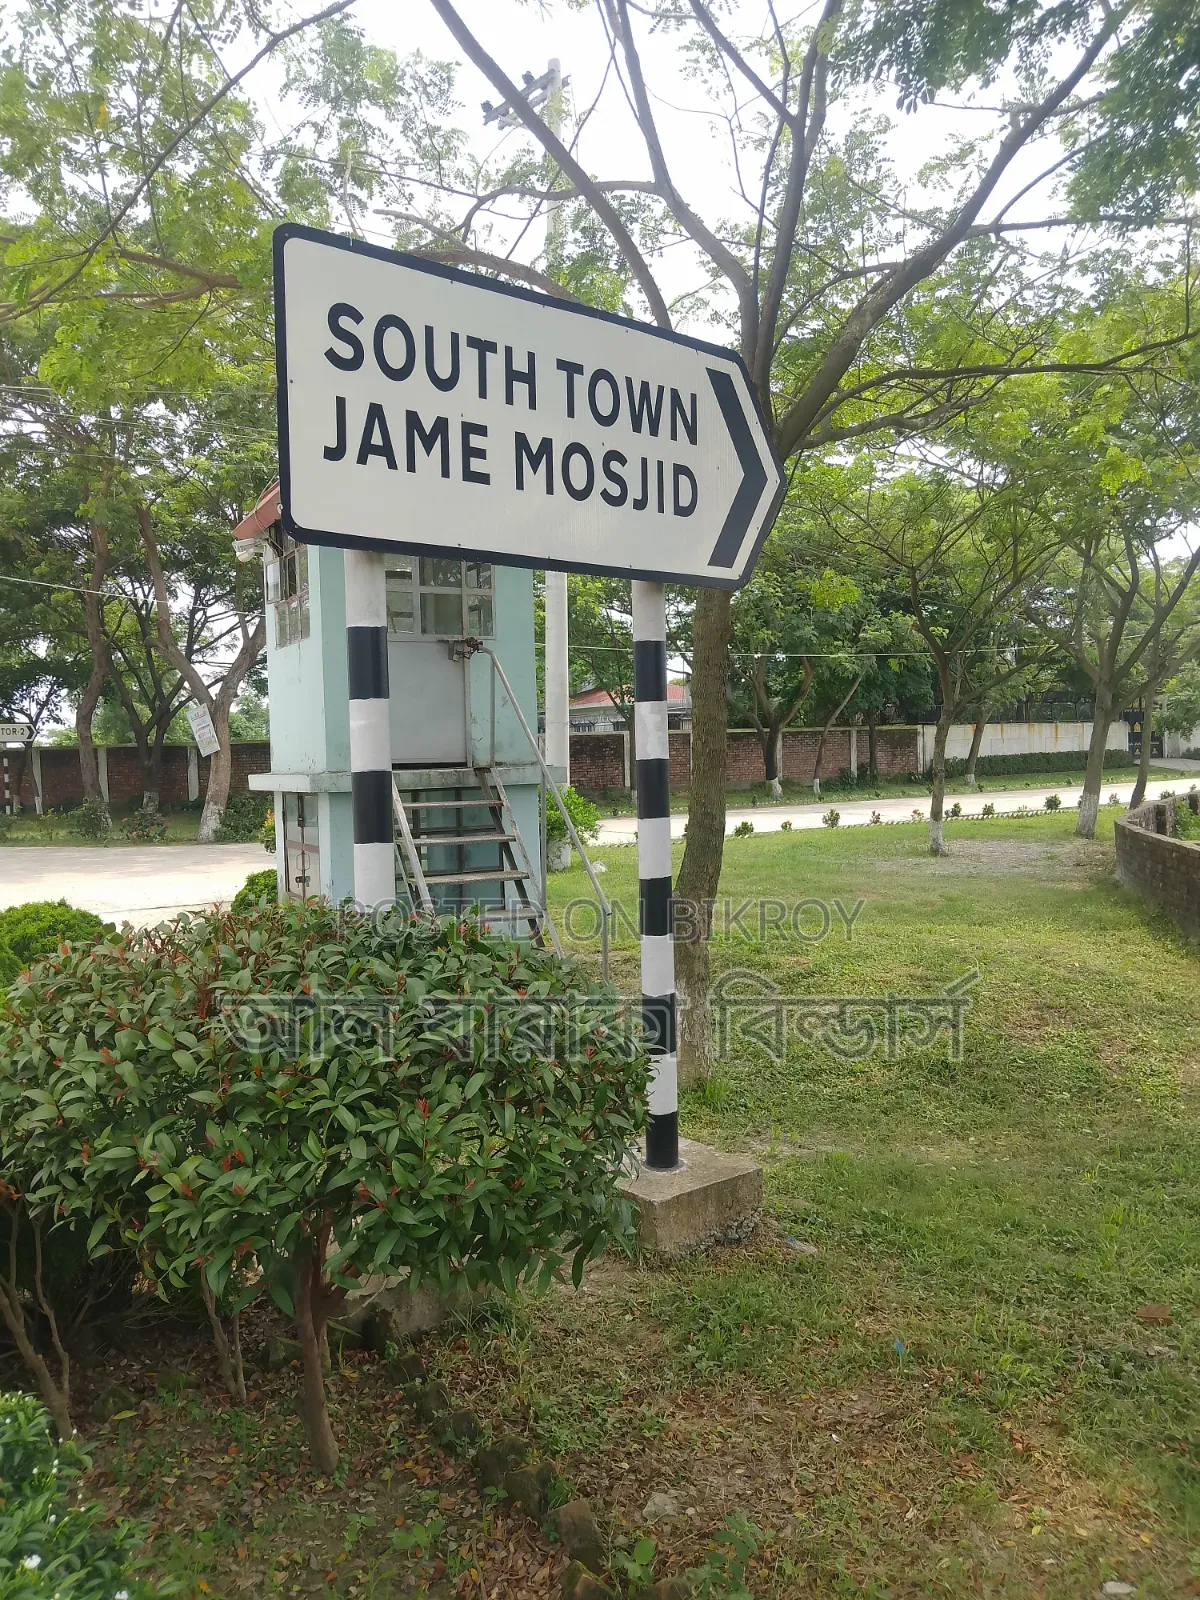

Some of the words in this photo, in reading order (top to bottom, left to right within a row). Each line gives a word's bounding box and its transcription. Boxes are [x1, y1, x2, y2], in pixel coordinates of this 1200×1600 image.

[324, 302, 537, 411] SOUTH
[556, 358, 698, 446] TOWN
[323, 396, 491, 486] JAME
[514, 431, 698, 518] MOSJID
